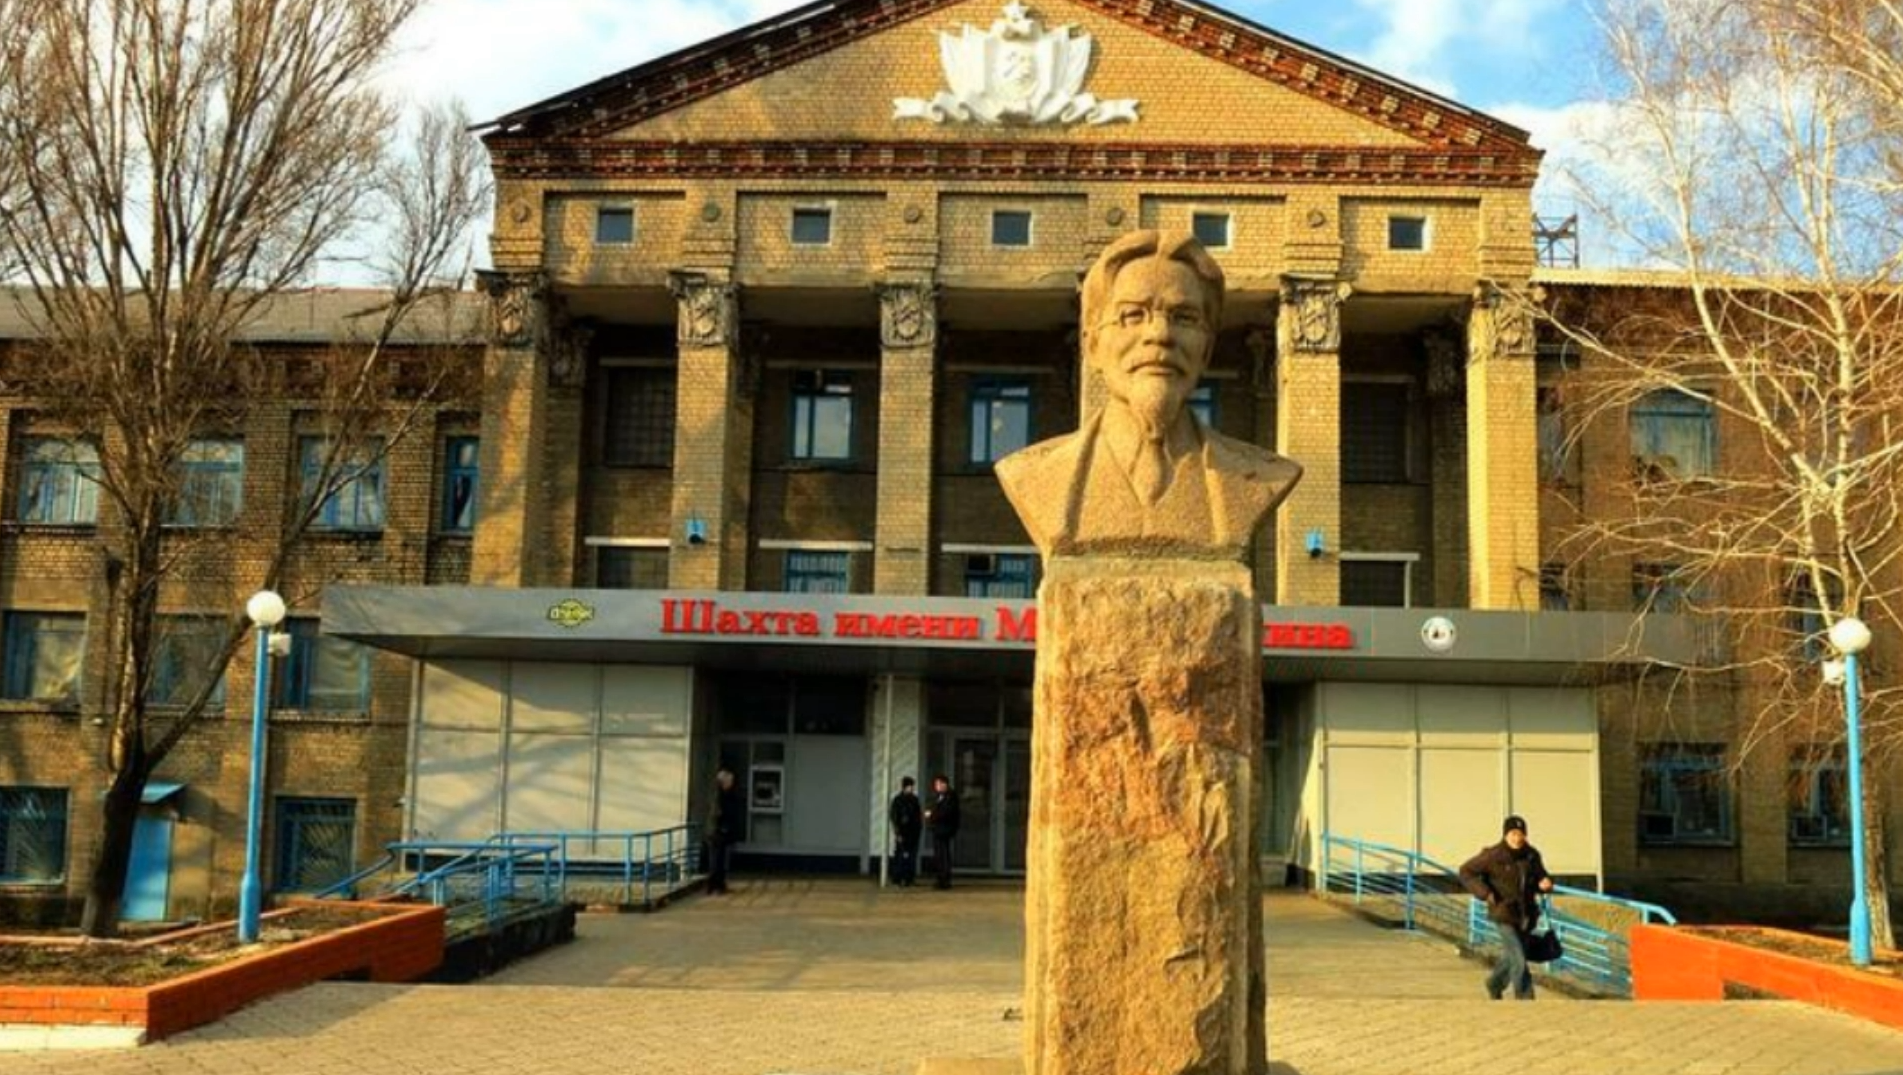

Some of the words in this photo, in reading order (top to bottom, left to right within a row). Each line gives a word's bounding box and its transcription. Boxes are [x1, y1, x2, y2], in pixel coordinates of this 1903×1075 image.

[661, 598, 819, 636] Шахта
[833, 612, 979, 640] имени
[1262, 622, 1355, 650] ина
